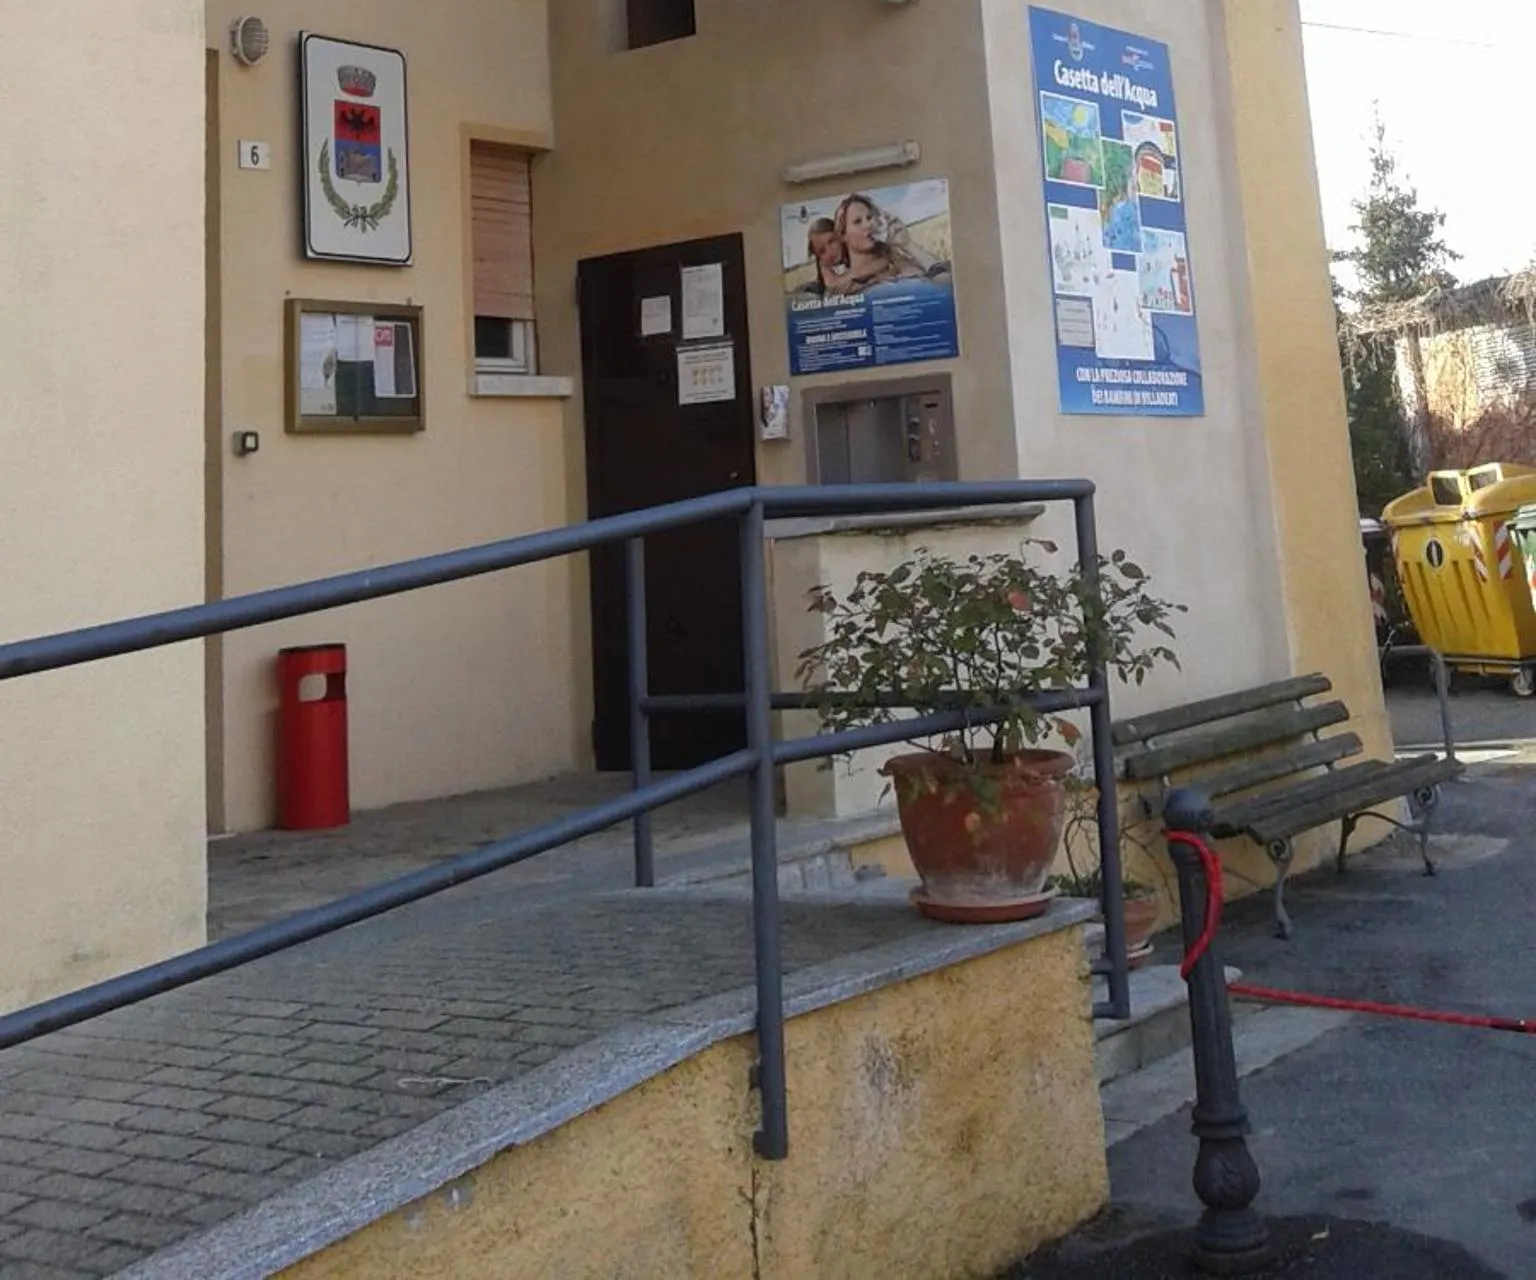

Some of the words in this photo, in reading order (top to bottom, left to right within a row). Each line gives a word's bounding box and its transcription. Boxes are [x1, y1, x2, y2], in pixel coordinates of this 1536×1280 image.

[1054, 58, 1099, 94] Casetta
[1100, 71, 1158, 111] dell'Acqua
[251, 145, 260, 166] 6
